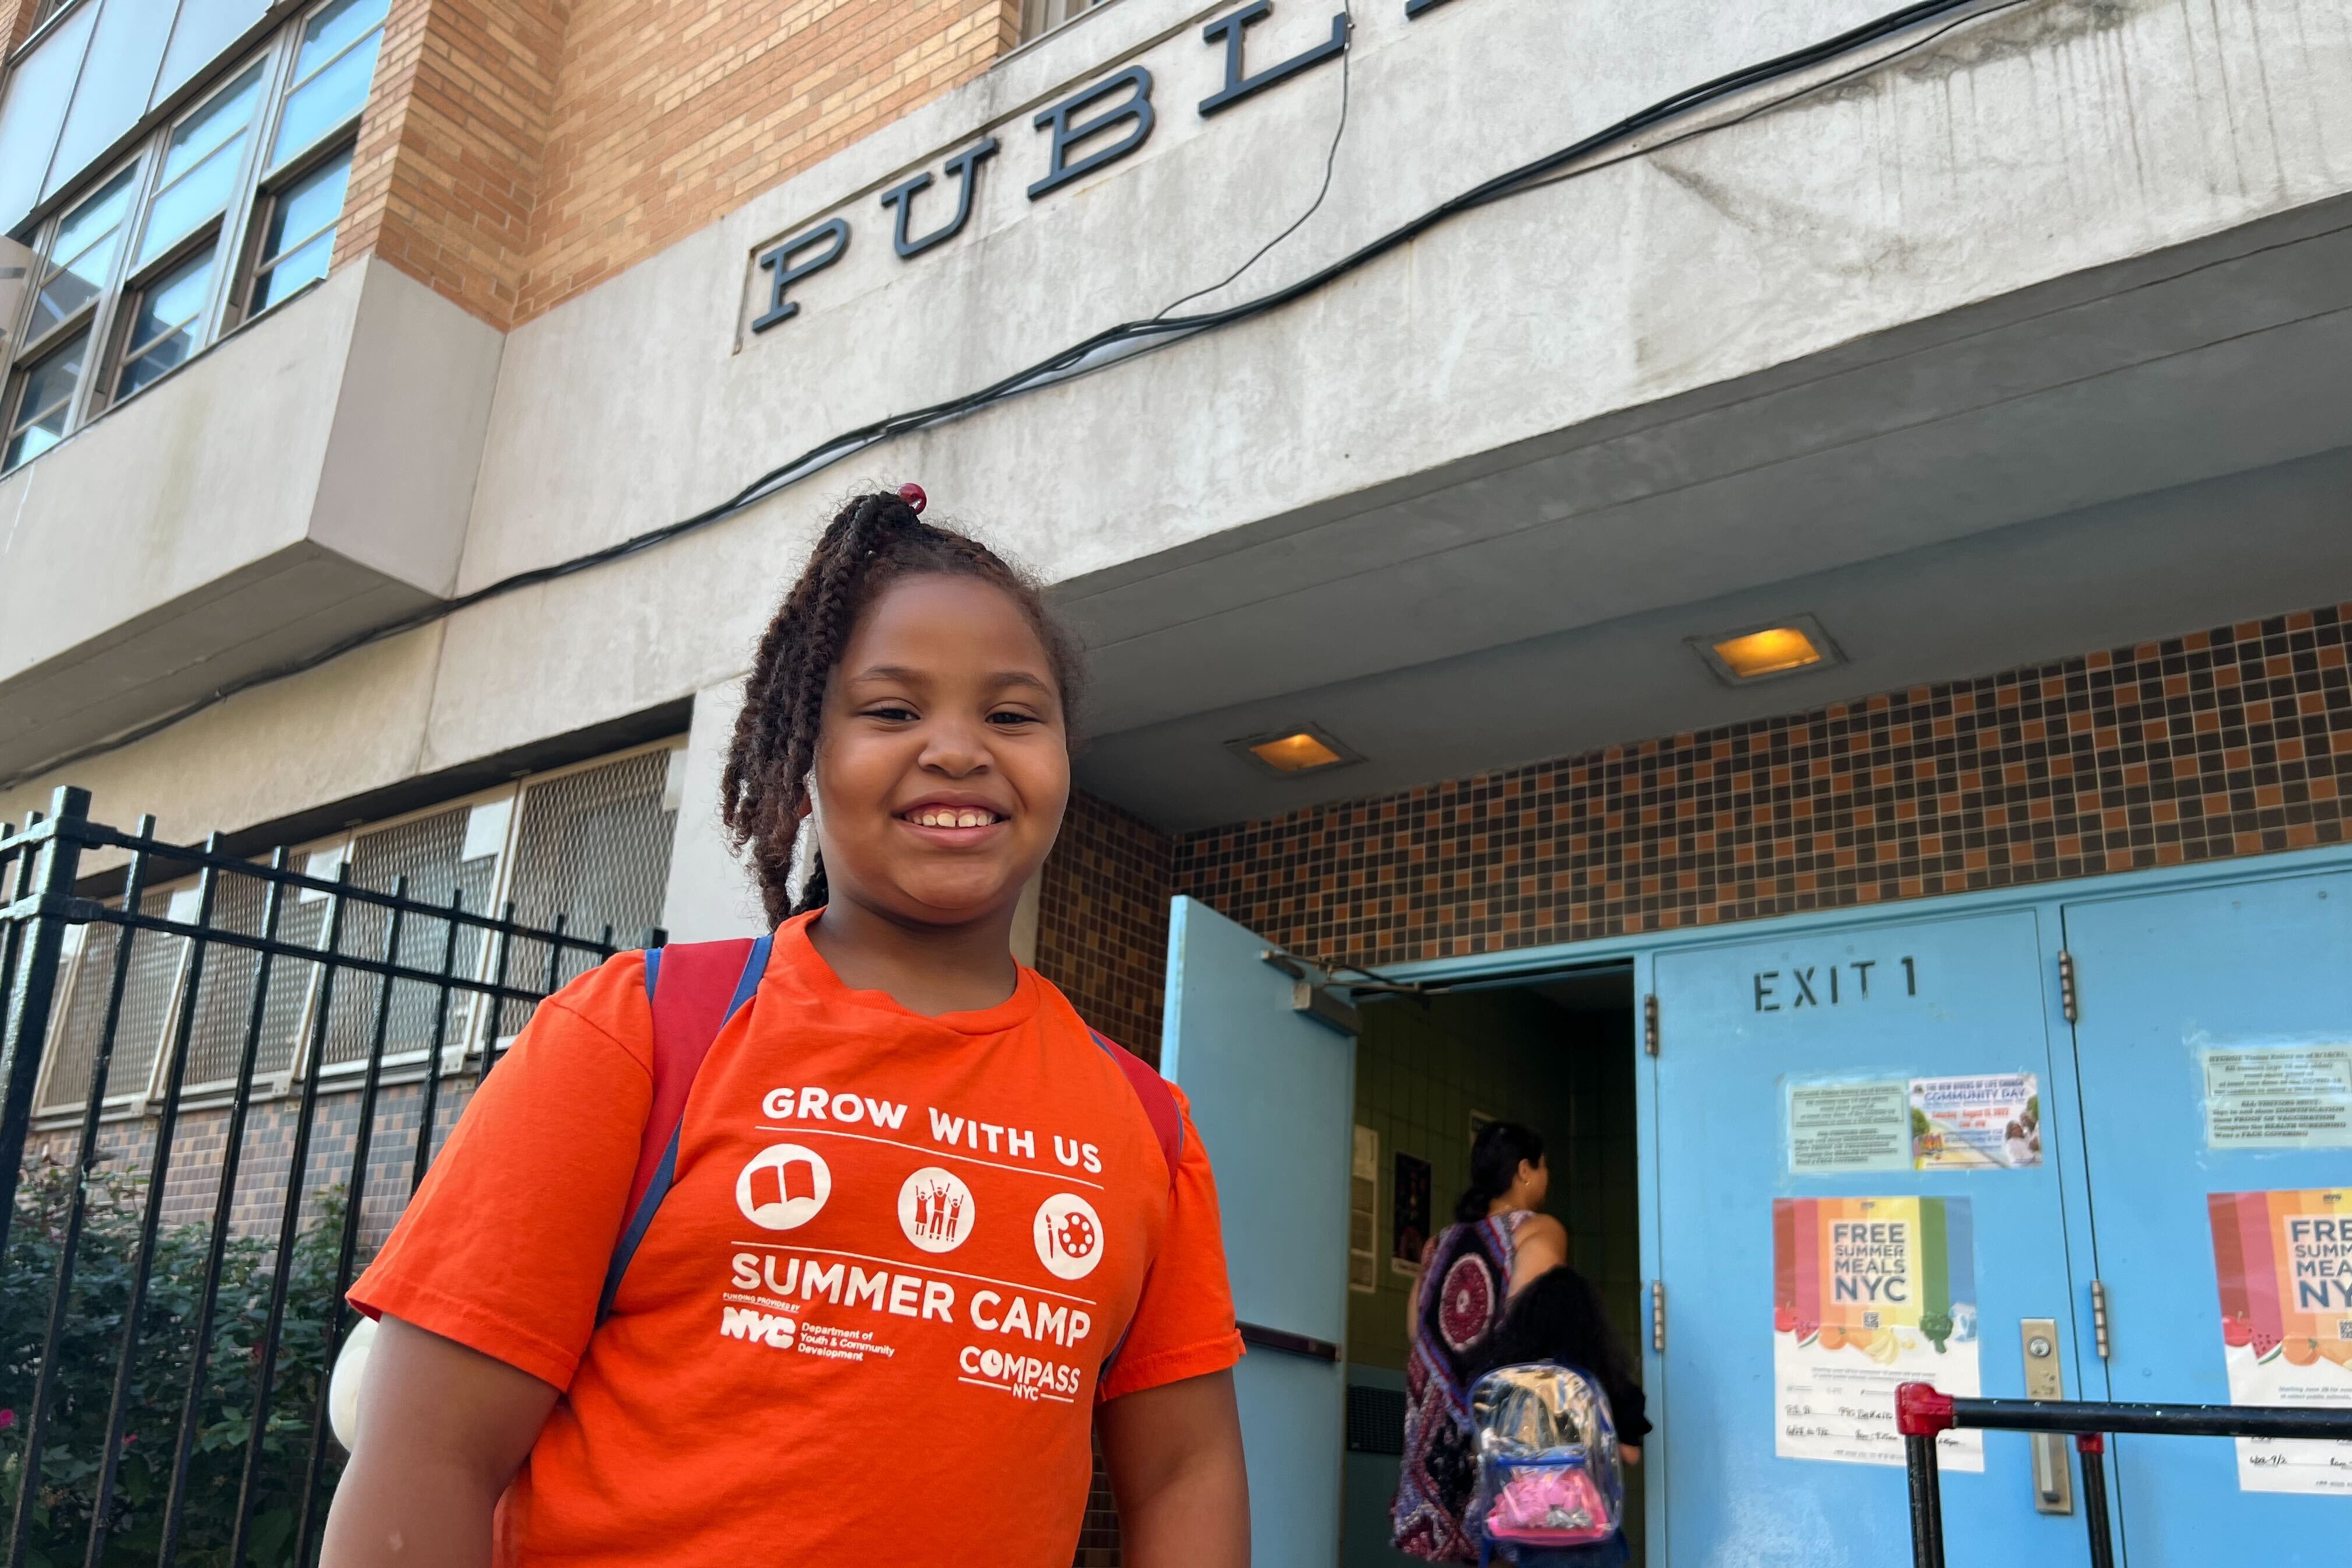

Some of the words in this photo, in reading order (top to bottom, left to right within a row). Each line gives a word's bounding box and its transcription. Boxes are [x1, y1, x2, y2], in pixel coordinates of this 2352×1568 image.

[752, 0, 1462, 334] PUBL
[1753, 959, 1876, 1012] EXIT
[1901, 955, 1916, 997] 1
[1925, 1090, 1998, 1101] COMMUNITY
[2002, 1088, 2025, 1098] DAY
[762, 1087, 908, 1129] GROW
[929, 1107, 1035, 1158] WITH
[1054, 1136, 1102, 1173] US
[1833, 1224, 1905, 1242] FREE
[1835, 1244, 1904, 1256] SUMMER
[1835, 1258, 1905, 1273] MEALS
[1835, 1276, 1906, 1301] NYC
[723, 1292, 755, 1303] FUNDING
[757, 1296, 790, 1310] PROVIDED
[790, 1304, 801, 1312] BY
[732, 1254, 954, 1322] SUMMER
[971, 1290, 1090, 1347] CAMP
[720, 1306, 796, 1349] NYC
[802, 1322, 860, 1339] Department
[862, 1332, 874, 1340] of
[798, 1342, 863, 1361] Development
[800, 1332, 828, 1345] Youth
[830, 1336, 837, 1346] &
[839, 1338, 895, 1357] Community
[960, 1346, 1081, 1394] COMPASS
[1013, 1382, 1039, 1401] NYC
